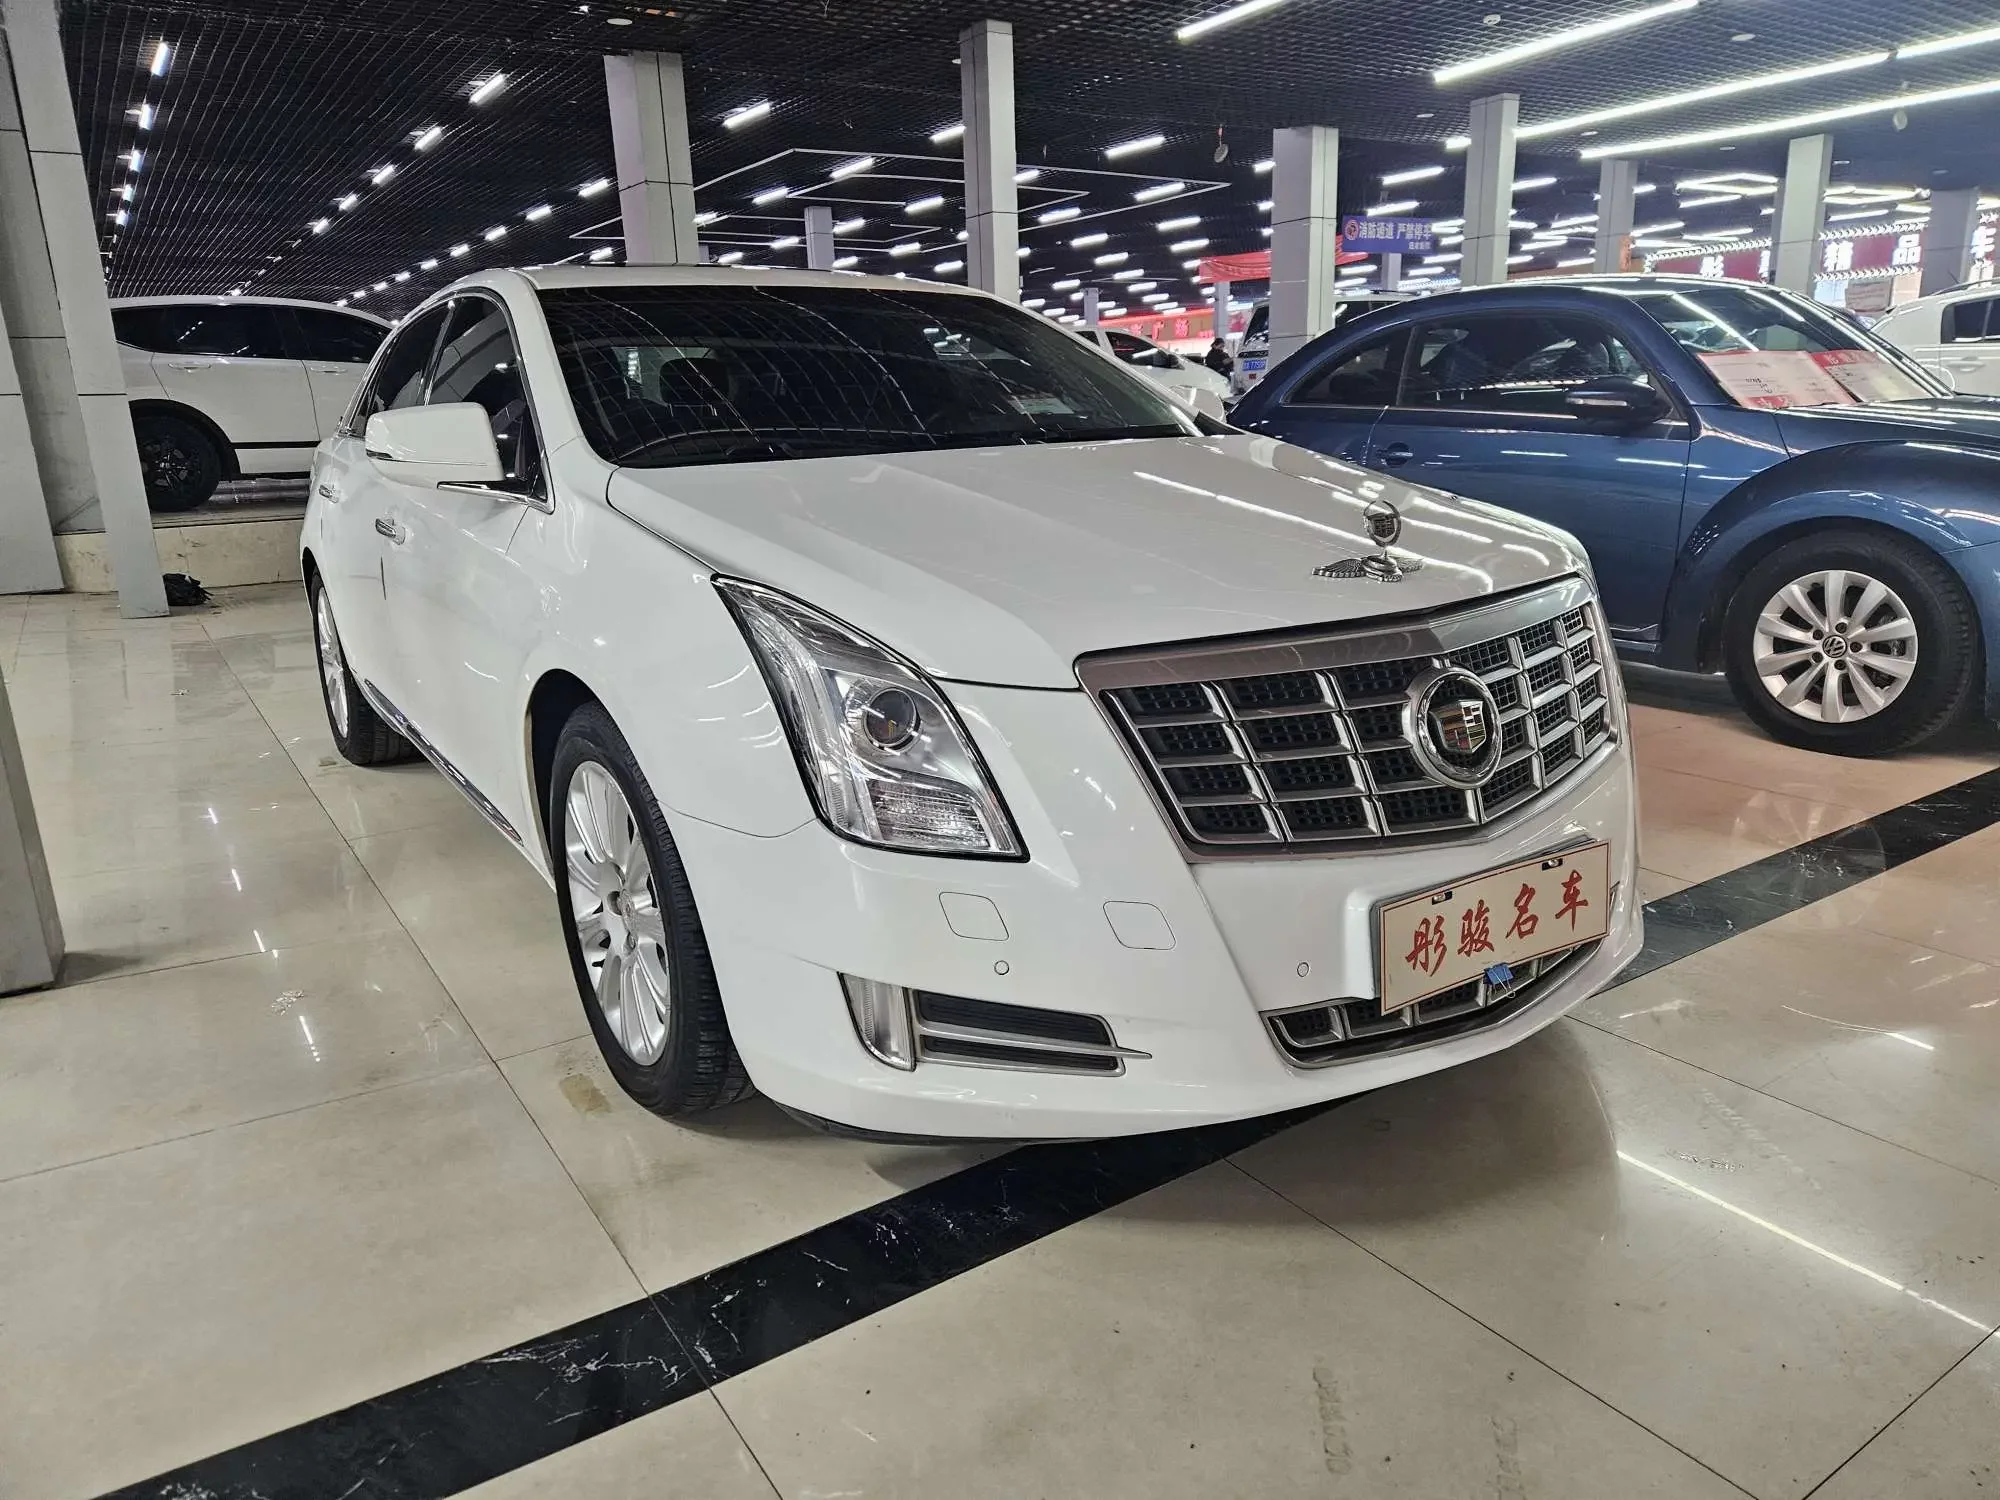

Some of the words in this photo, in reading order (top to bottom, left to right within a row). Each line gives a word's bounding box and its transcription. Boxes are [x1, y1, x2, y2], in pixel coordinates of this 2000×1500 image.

[1359, 221, 1395, 239] 消防通道
[1404, 869, 1589, 977] 彤骏名车
